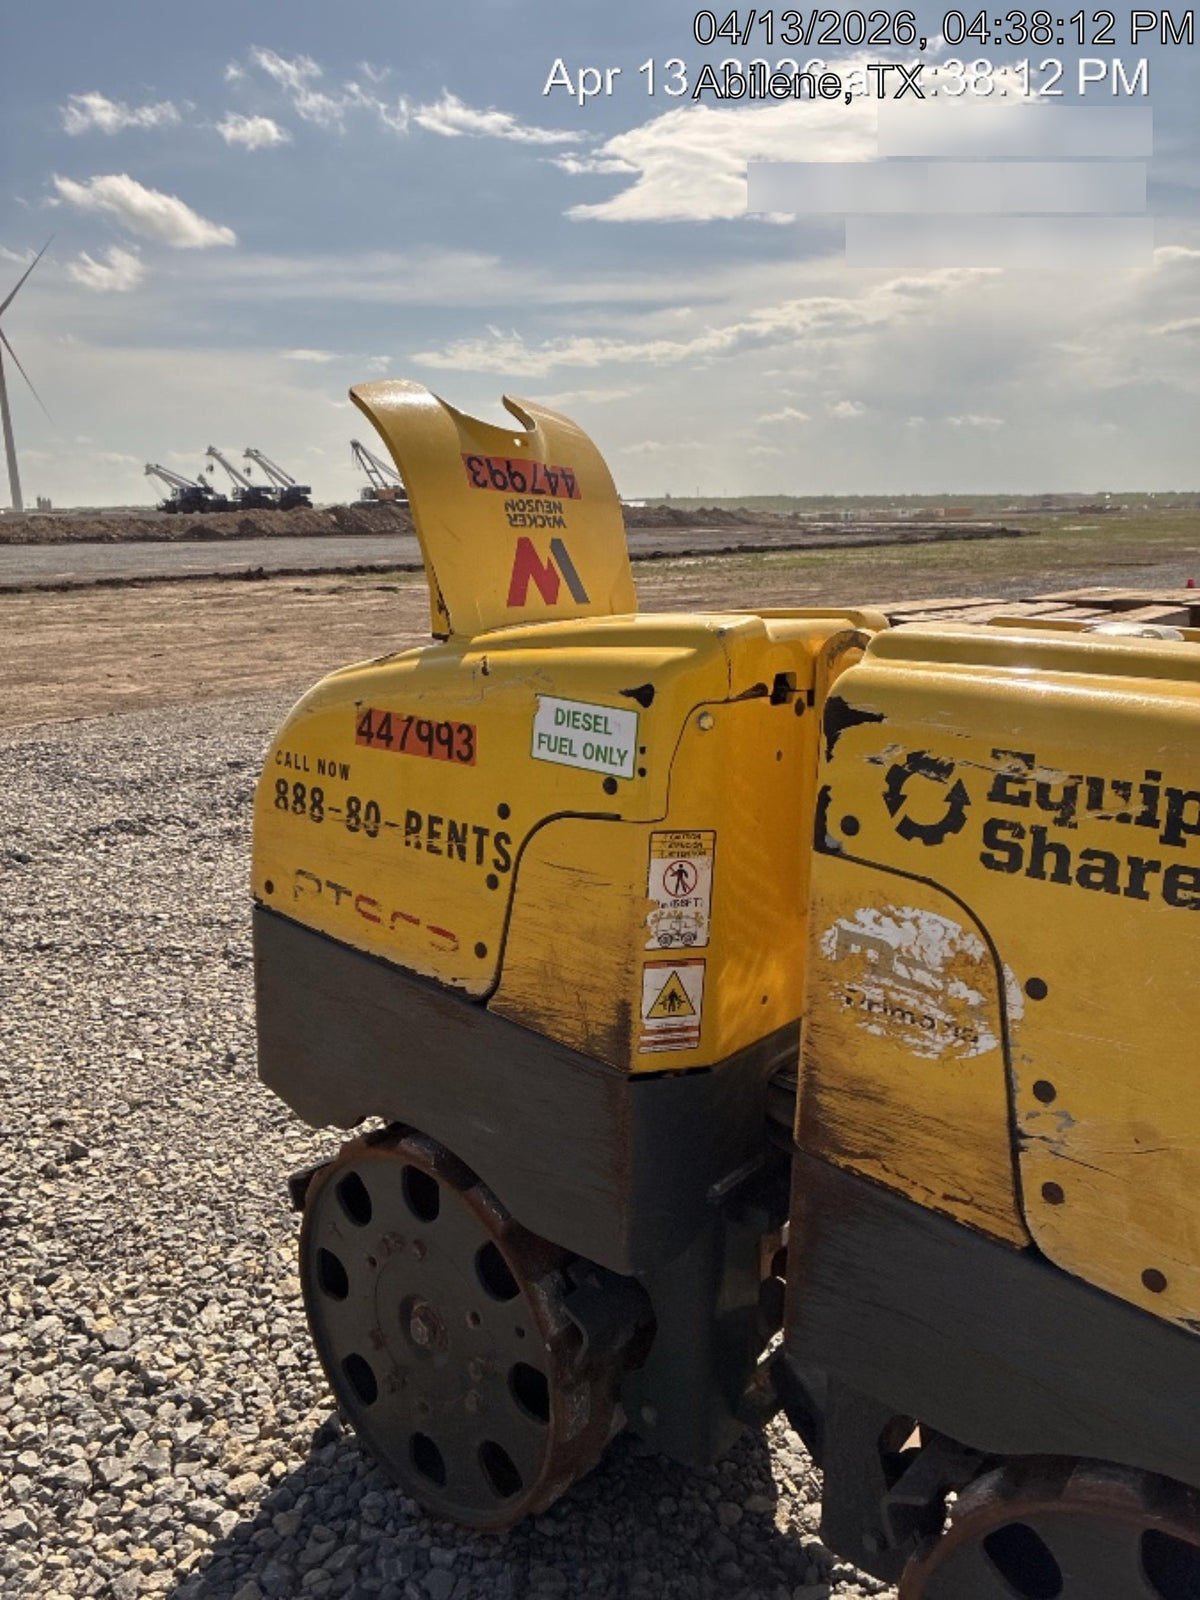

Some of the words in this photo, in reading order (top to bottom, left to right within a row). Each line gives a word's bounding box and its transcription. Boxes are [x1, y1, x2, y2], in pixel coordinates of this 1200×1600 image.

[466, 456, 576, 499] 447993
[504, 499, 563, 514] NEUSON
[507, 513, 567, 529] WACKER
[356, 707, 474, 763] 447993
[554, 707, 613, 735] DIESEL
[275, 749, 310, 772] CALL
[317, 758, 351, 781] NOW
[537, 732, 578, 758] FUEL
[582, 742, 629, 767] ONLY
[273, 778, 513, 874] 888-80-RENTS
[979, 817, 1200, 911] Share
